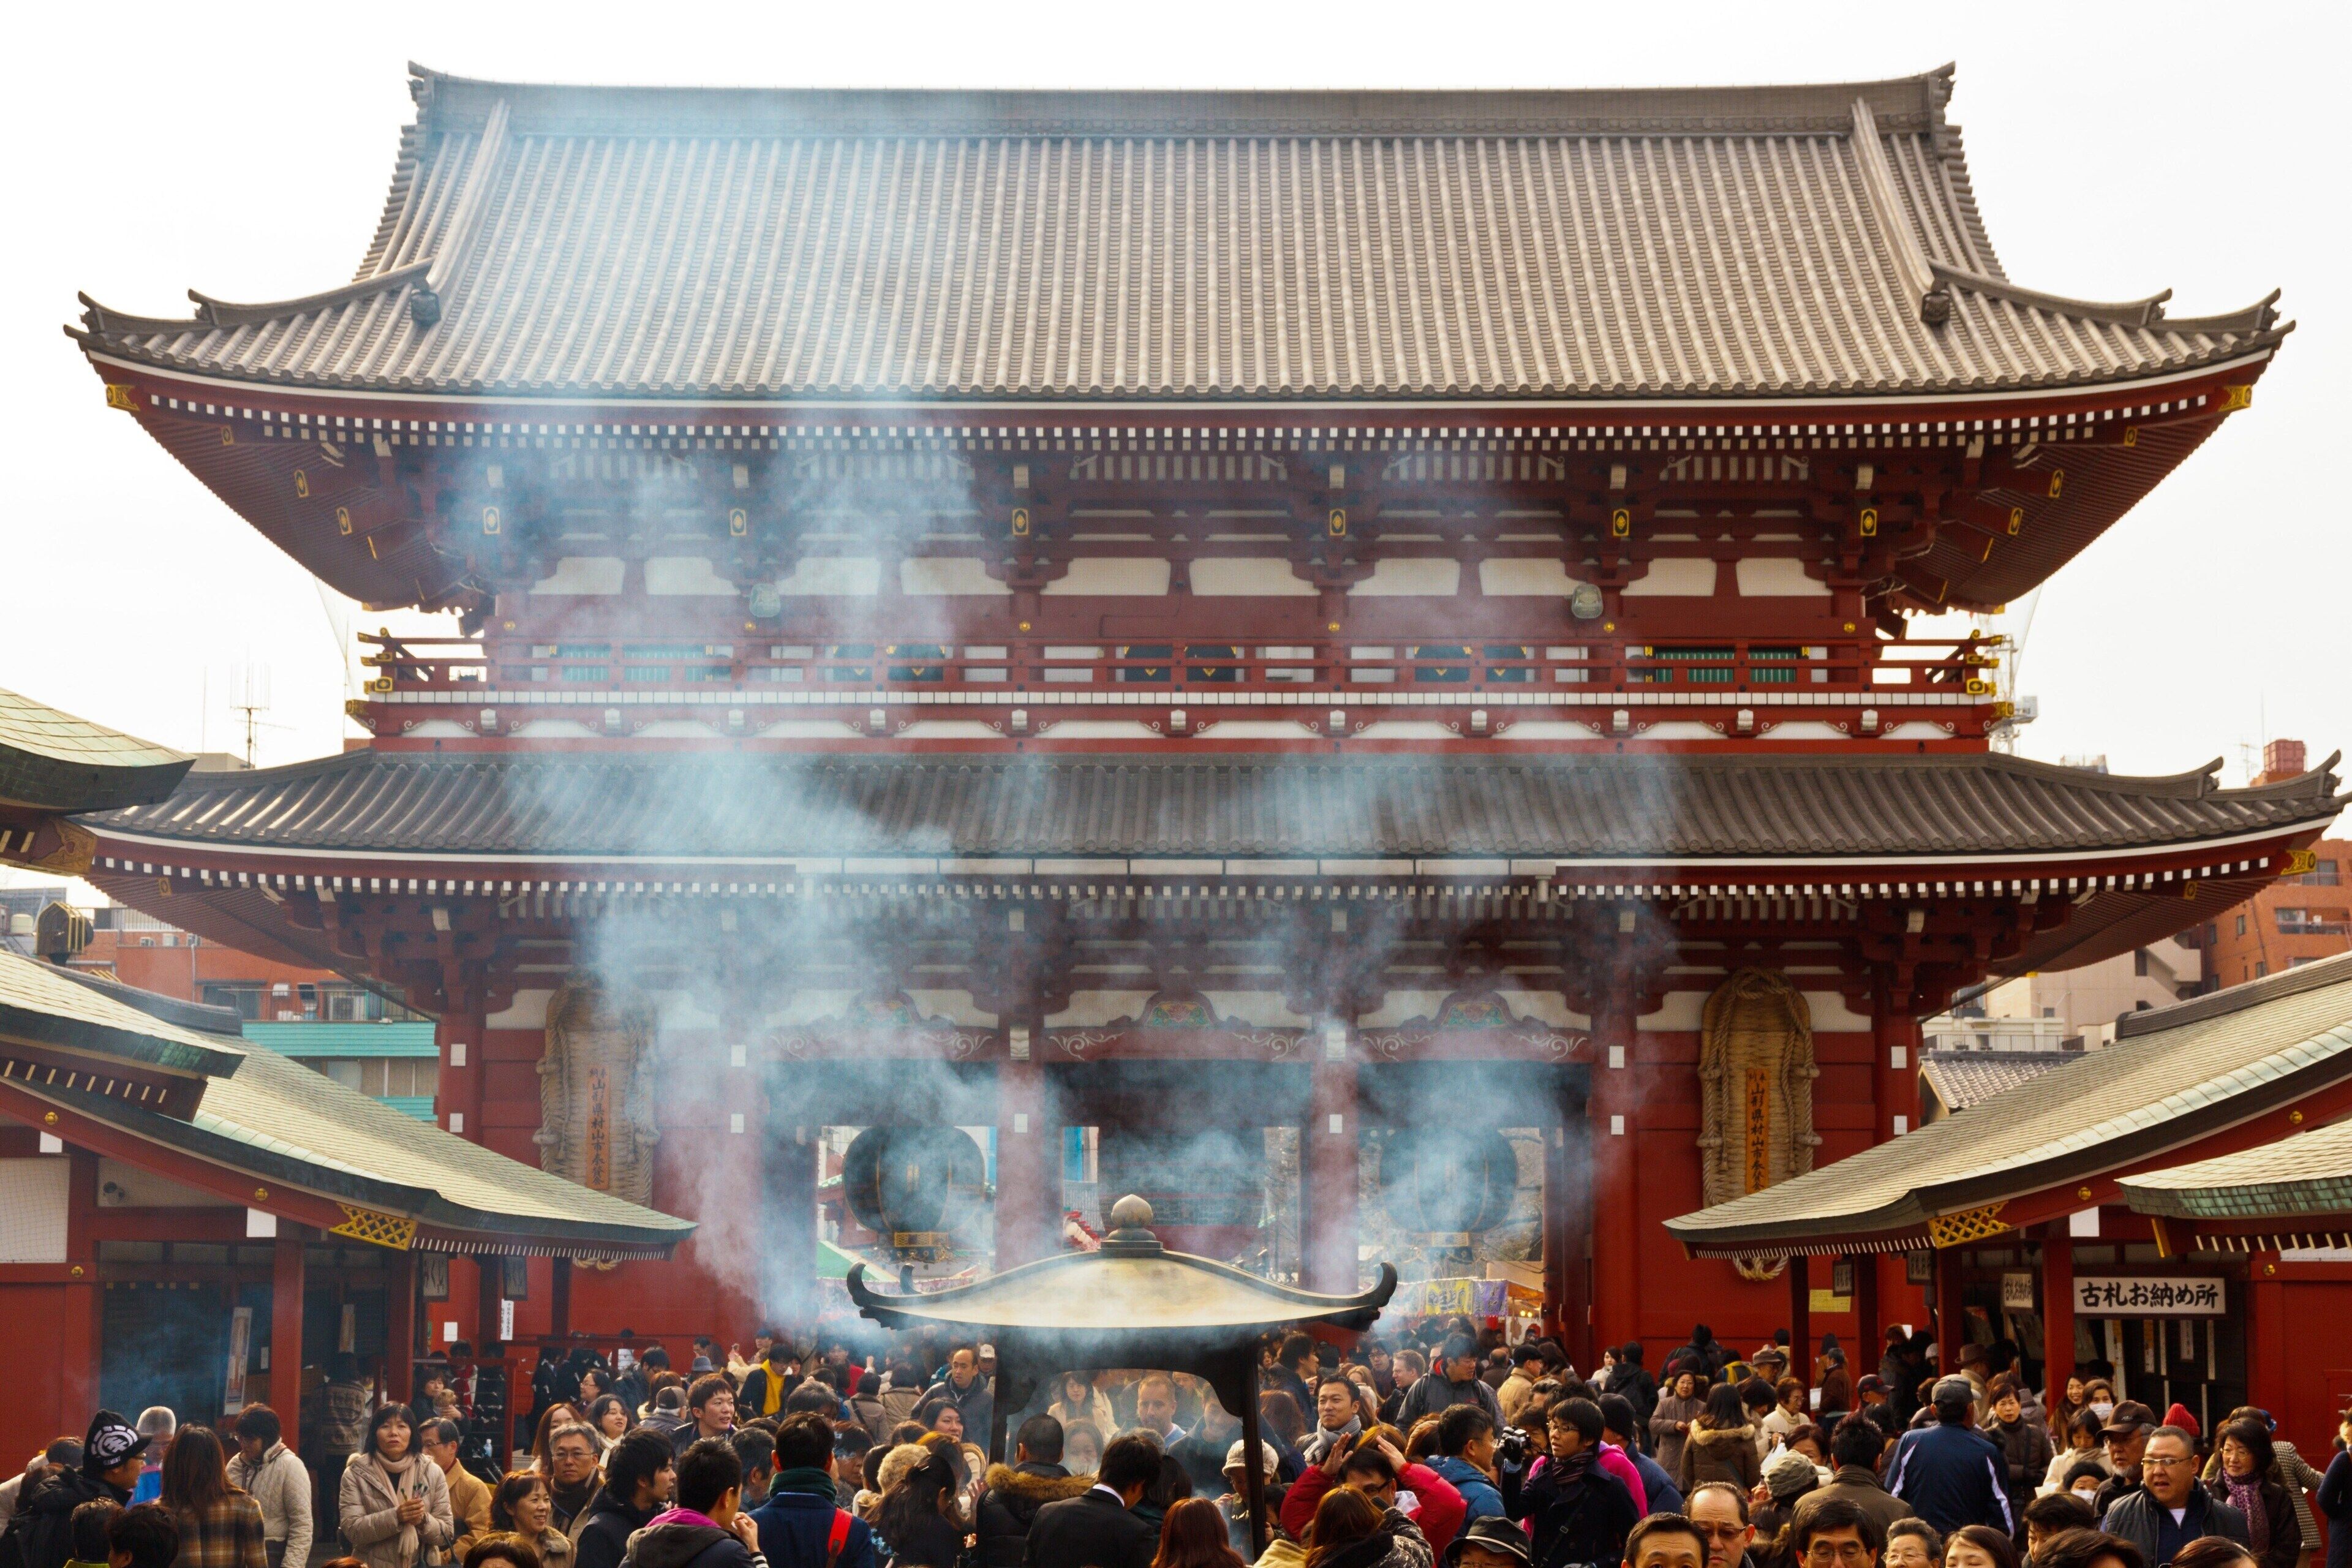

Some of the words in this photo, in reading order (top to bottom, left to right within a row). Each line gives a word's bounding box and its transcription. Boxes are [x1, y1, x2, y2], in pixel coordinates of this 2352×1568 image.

[2080, 1281, 2218, 1309] 古札お納め所
